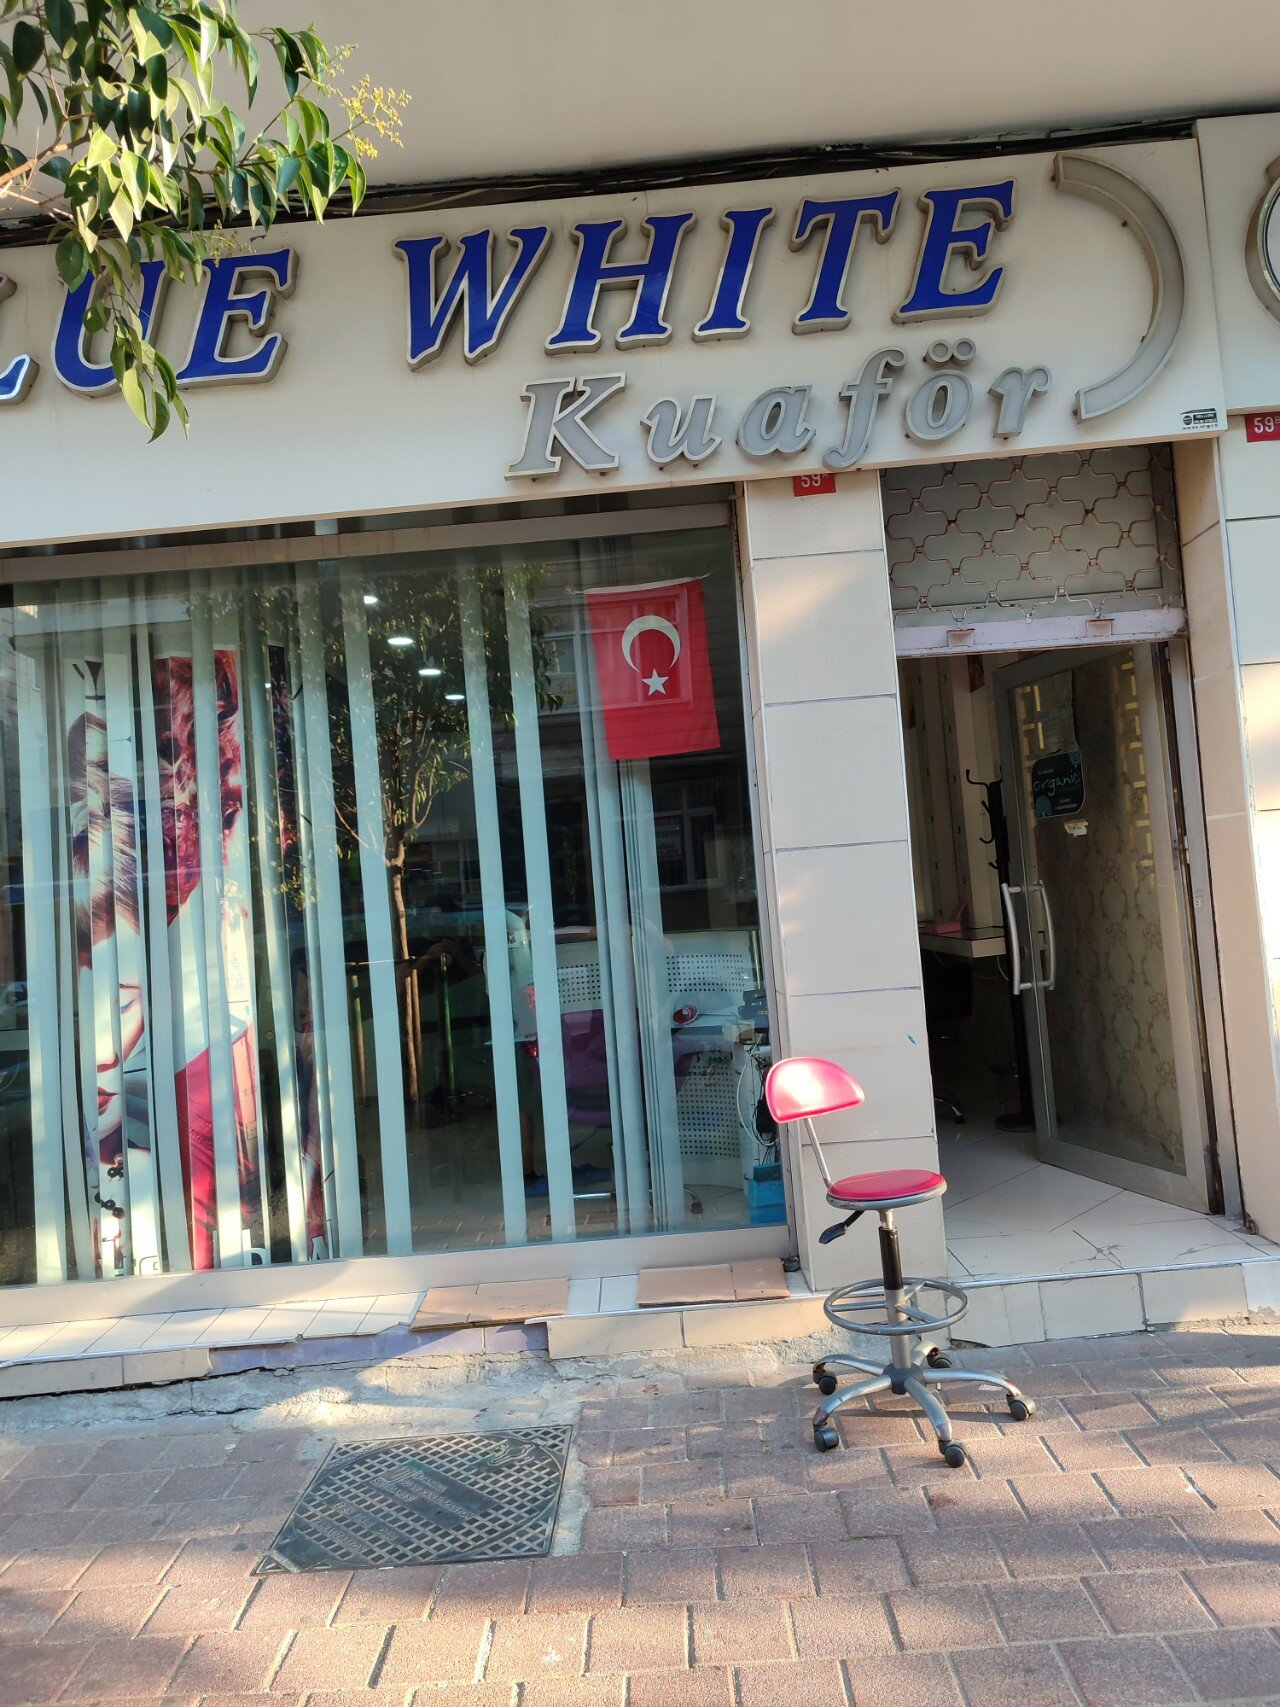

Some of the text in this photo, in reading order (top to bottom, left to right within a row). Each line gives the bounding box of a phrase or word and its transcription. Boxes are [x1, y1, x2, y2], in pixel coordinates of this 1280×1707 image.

[0, 177, 1016, 404] UE WHITE
[504, 337, 1051, 480] Kuaför
[1034, 768, 1081, 796] organic
